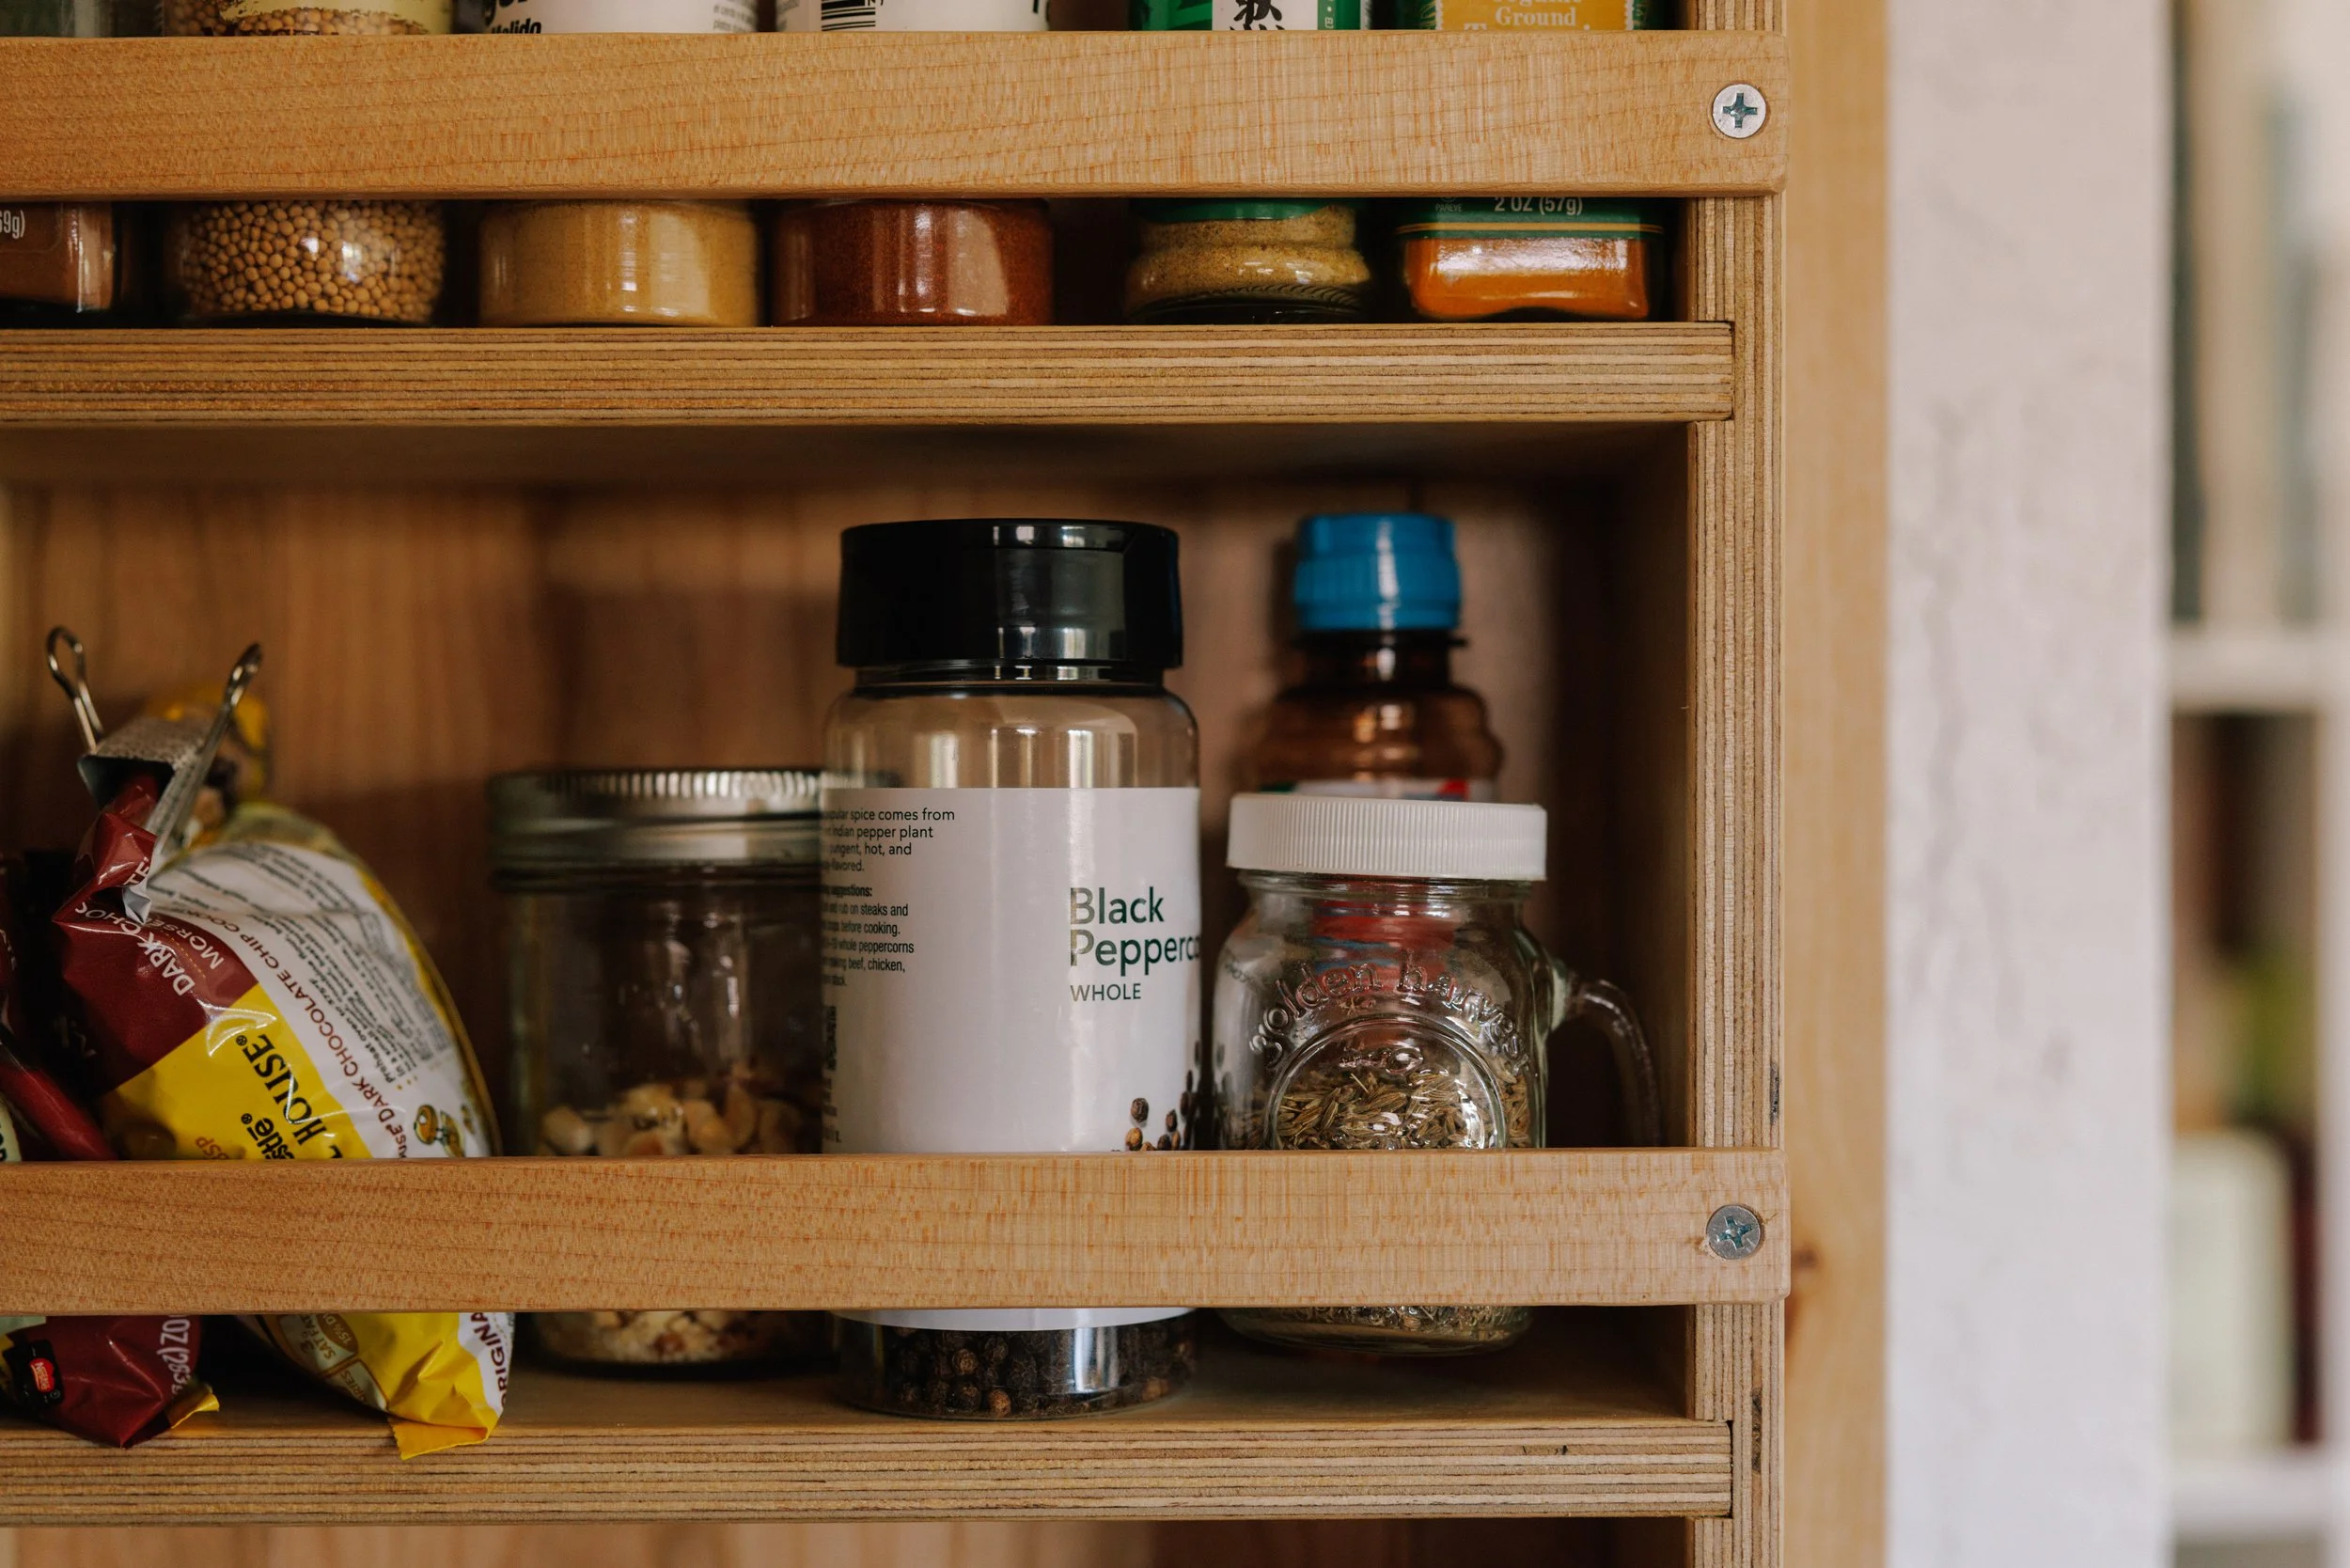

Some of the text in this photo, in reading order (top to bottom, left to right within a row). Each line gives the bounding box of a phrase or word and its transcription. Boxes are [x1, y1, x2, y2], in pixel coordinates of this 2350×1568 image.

[1495, 7, 1576, 26] Ground
[1495, 196, 1505, 212] 2
[1539, 196, 1583, 215] (57g)
[0, 210, 25, 239] 9g)
[851, 808, 875, 823] spice
[878, 810, 918, 821] comes
[922, 808, 955, 821] from
[856, 827, 897, 840] pepper
[900, 825, 933, 840] plant
[865, 842, 885, 856] hot,
[888, 842, 912, 855] and
[861, 903, 888, 917] steaks
[890, 903, 908, 917] and
[1070, 886, 1165, 925] Black
[864, 921, 901, 937] cooking.
[241, 933, 279, 969] CHIP
[858, 941, 915, 955] peppercorns
[137, 932, 195, 996] DARK
[868, 959, 906, 973] chicken,
[1070, 983, 1142, 1002] WHOLE
[276, 969, 358, 1076] CHOCOLATE
[344, 1017, 367, 1042] oven
[364, 1043, 395, 1084] Preheat
[352, 1076, 395, 1123] DARK
